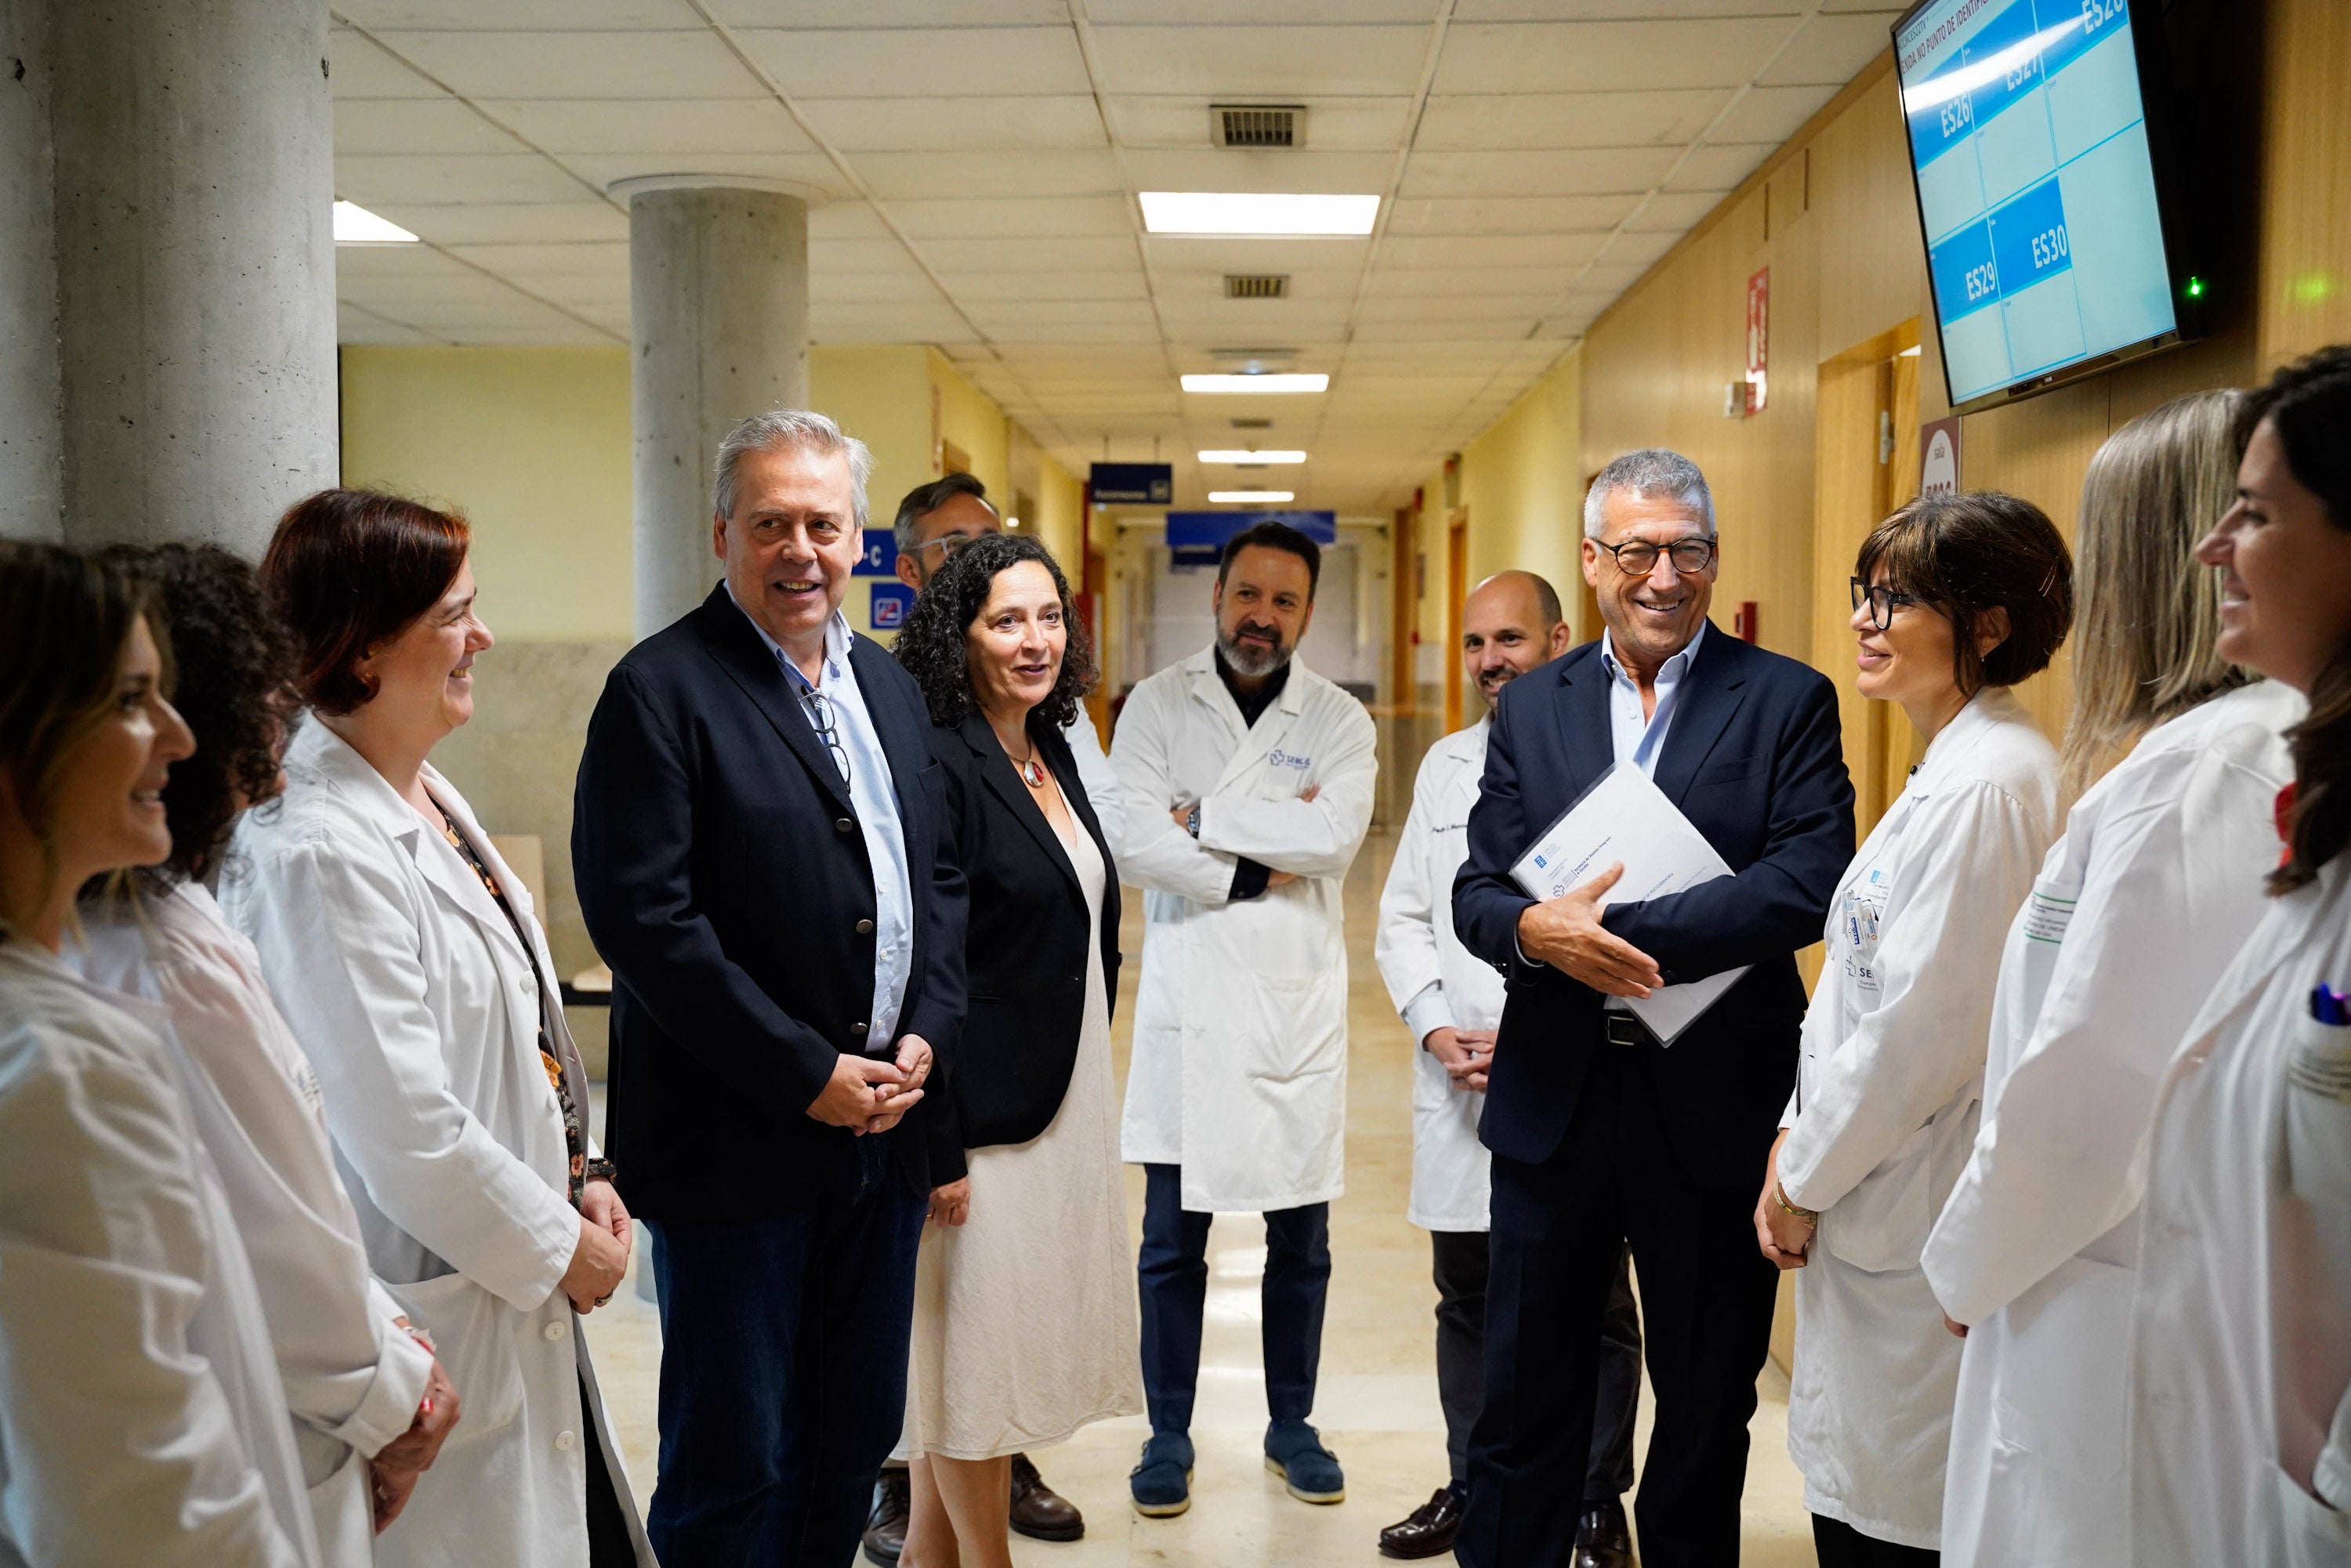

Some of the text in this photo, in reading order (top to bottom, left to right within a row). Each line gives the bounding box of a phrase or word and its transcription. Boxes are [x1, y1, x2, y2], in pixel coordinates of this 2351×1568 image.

[1916, 42, 1926, 63] NO
[1926, 24, 1947, 53] PUNTO
[1947, 16, 1956, 36] DE
[1956, 0, 1989, 27] IDENTIF
[1940, 92, 1971, 139] ES26
[2031, 224, 2068, 270] ES30
[1965, 261, 1996, 301] ES29
[1859, 967, 1875, 979] SE
